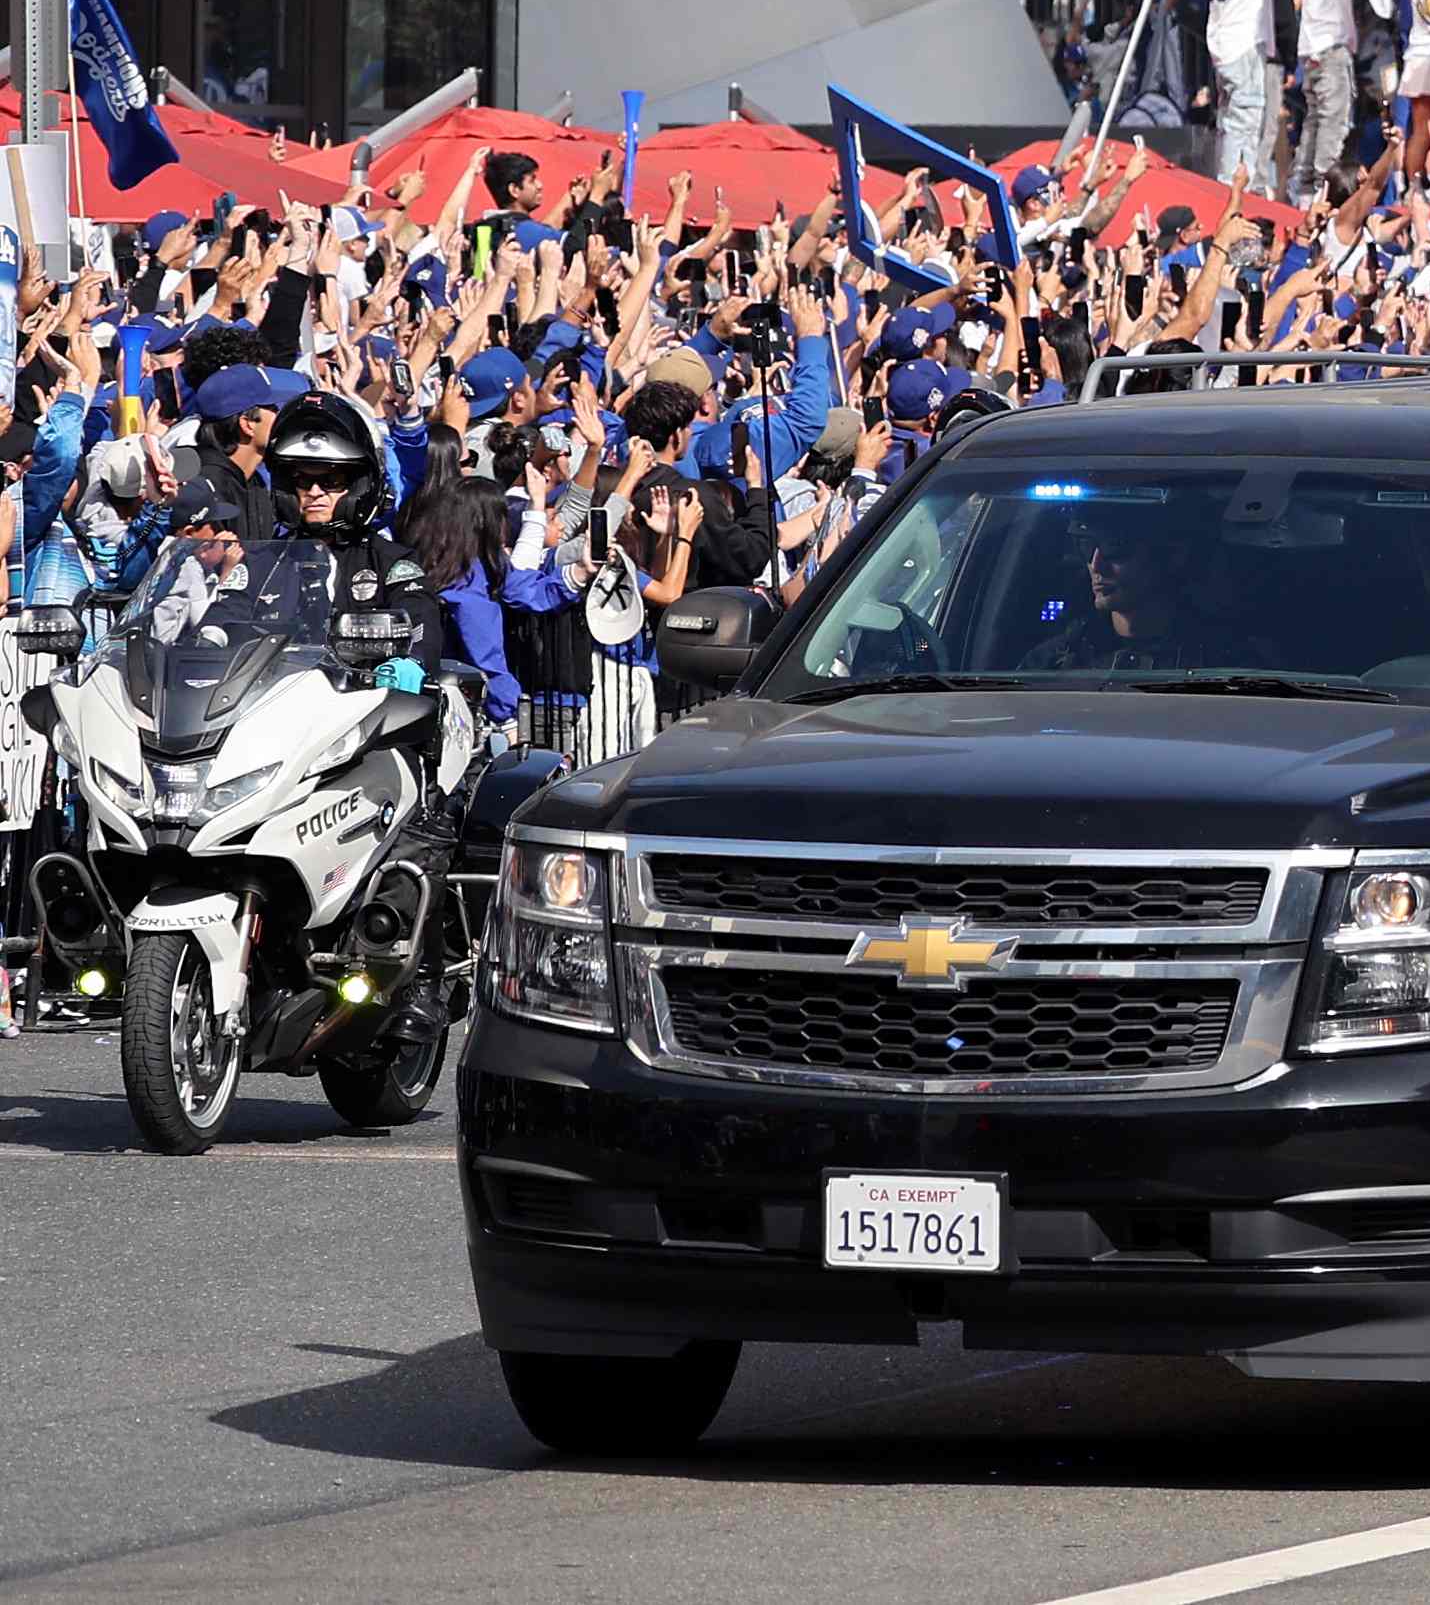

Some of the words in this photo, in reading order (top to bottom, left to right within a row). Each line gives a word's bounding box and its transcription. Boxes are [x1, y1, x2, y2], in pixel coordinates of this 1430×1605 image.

[295, 792, 360, 845] POLICE
[140, 914, 188, 928] DRILL
[189, 913, 227, 926] TEAM
[869, 1189, 889, 1201] CA
[898, 1190, 957, 1203] EXEMPT
[837, 1210, 986, 1256] 1517861
